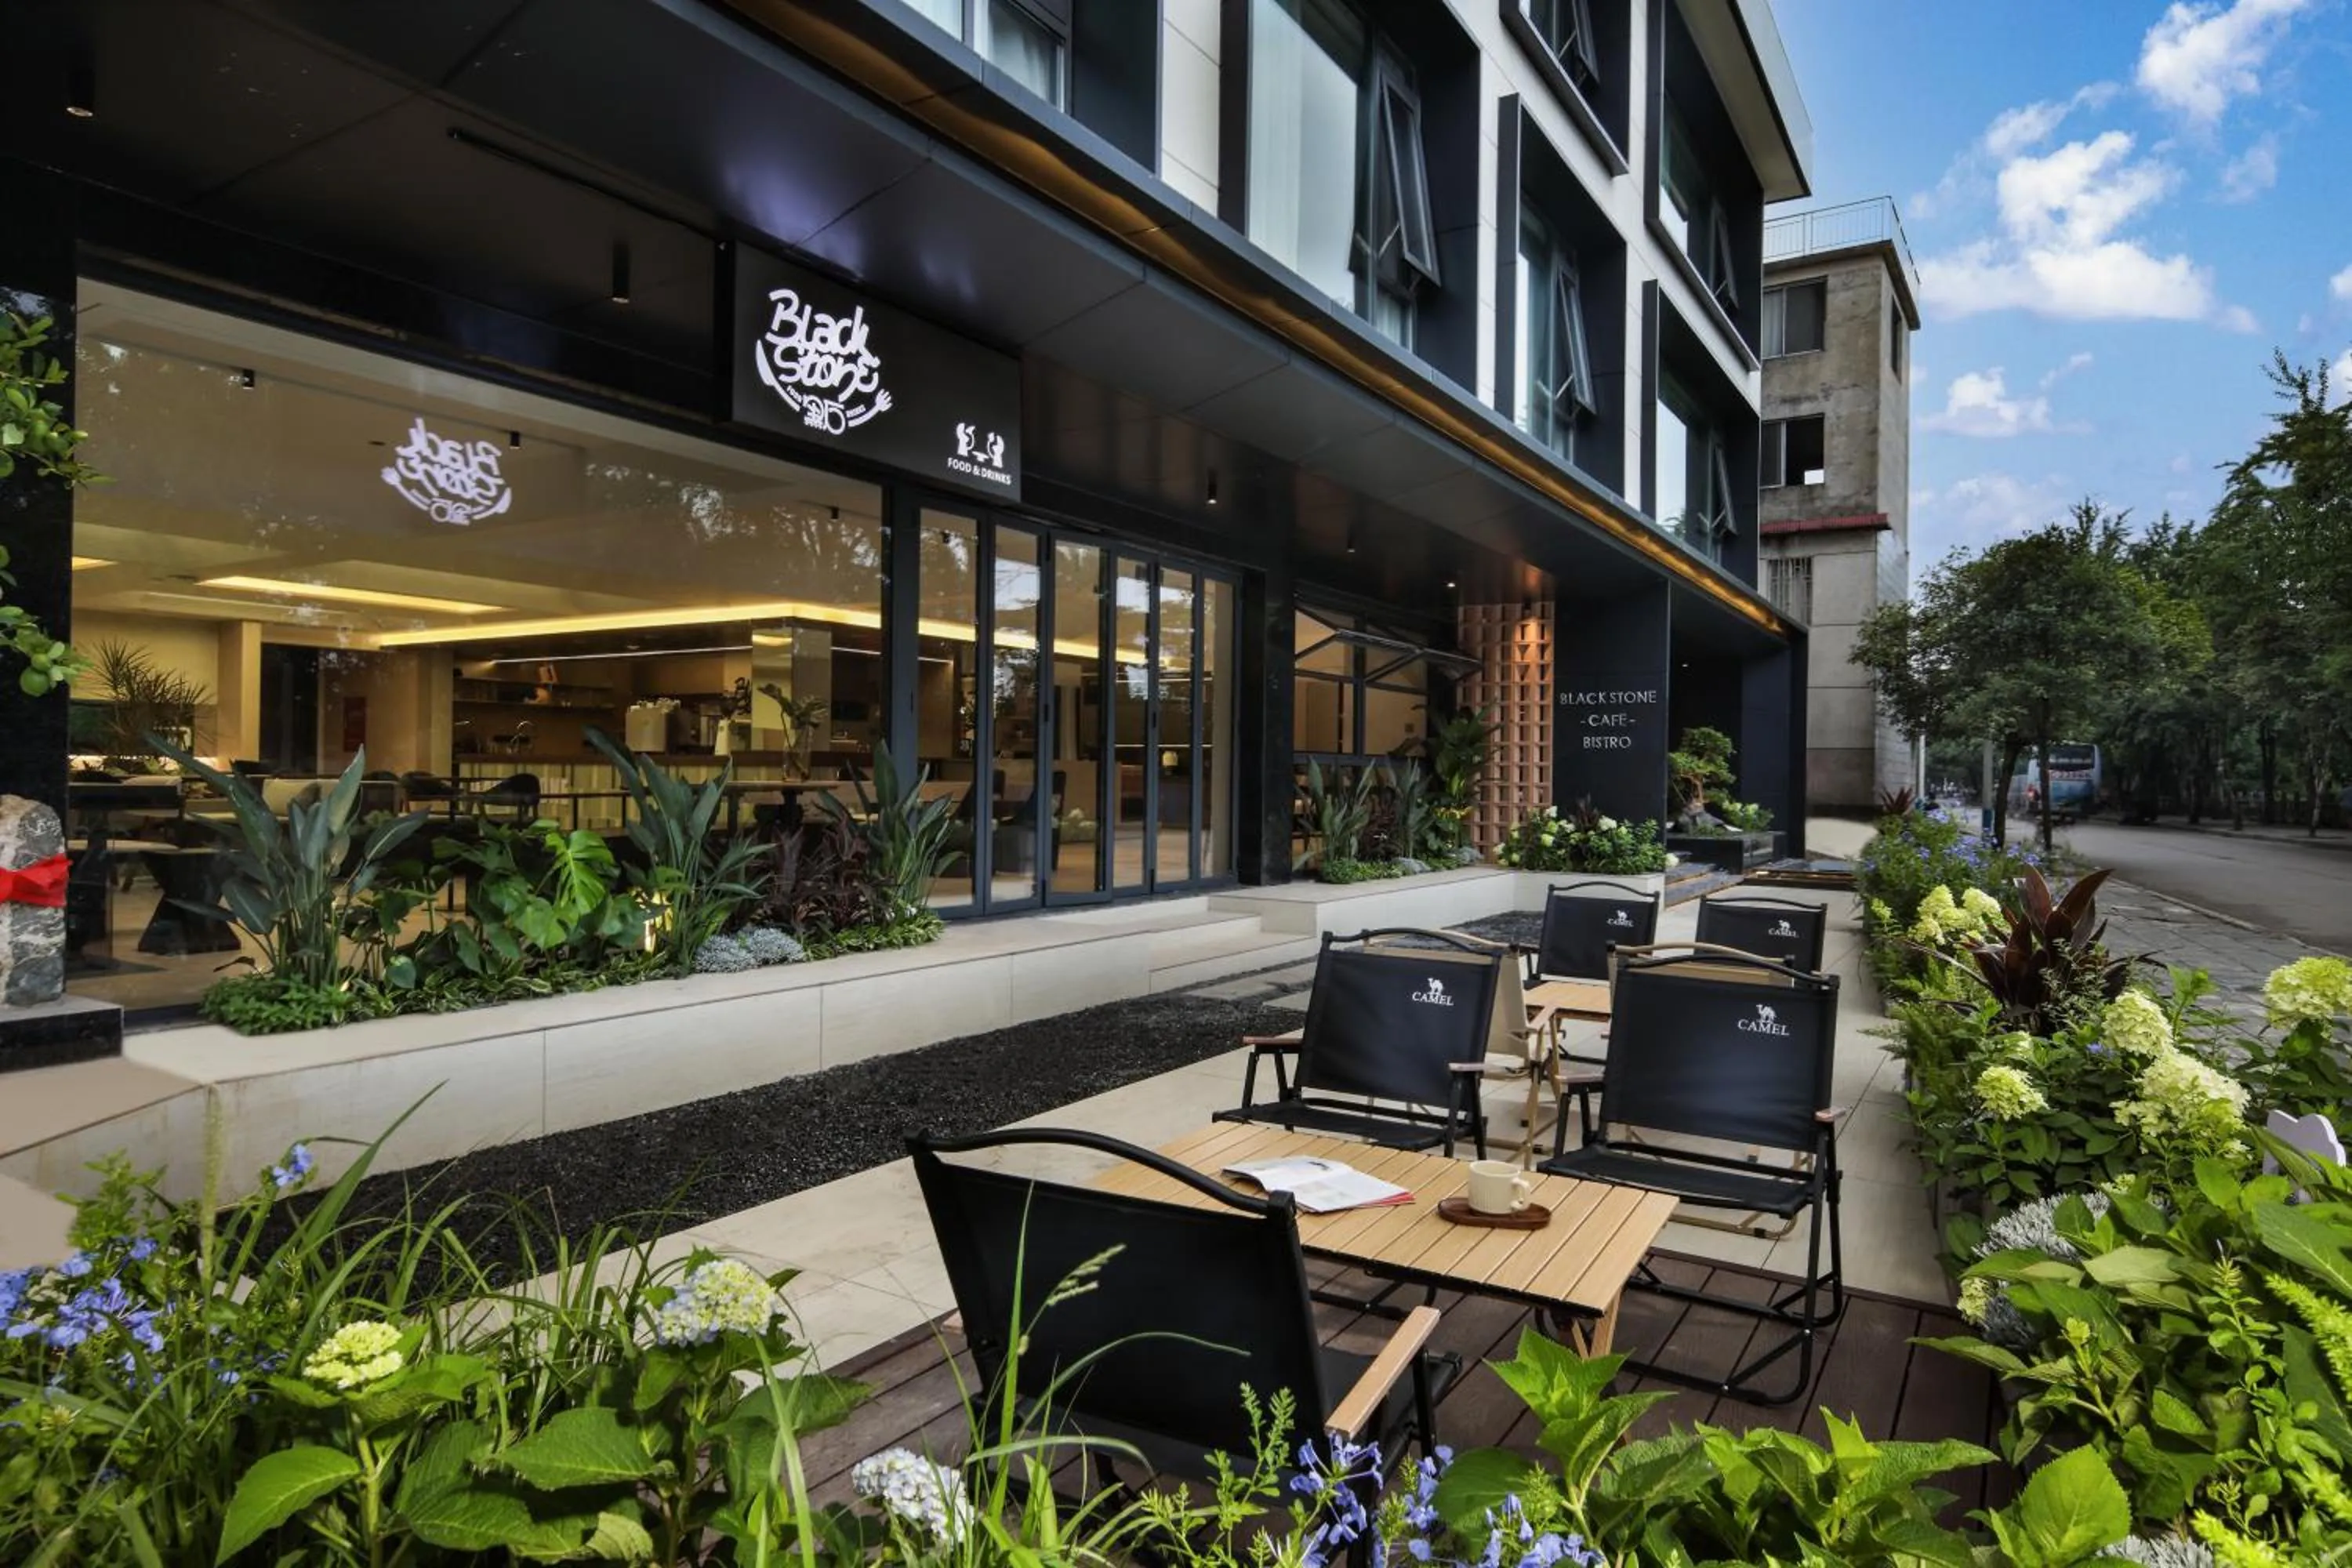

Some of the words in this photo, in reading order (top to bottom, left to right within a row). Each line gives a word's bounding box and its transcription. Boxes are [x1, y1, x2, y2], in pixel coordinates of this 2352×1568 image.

[765, 289, 880, 368] Black
[947, 457, 972, 474] FOOD
[973, 465, 981, 477] &
[981, 467, 1011, 485] DRINKS
[1559, 691, 1606, 705] BLACK
[1609, 690, 1657, 704] STONE
[1583, 735, 1632, 749] BISTRO
[1768, 927, 1800, 938] CAMEL
[1411, 991, 1454, 1007] CAMEL
[1737, 1018, 1790, 1036] CAMEL
